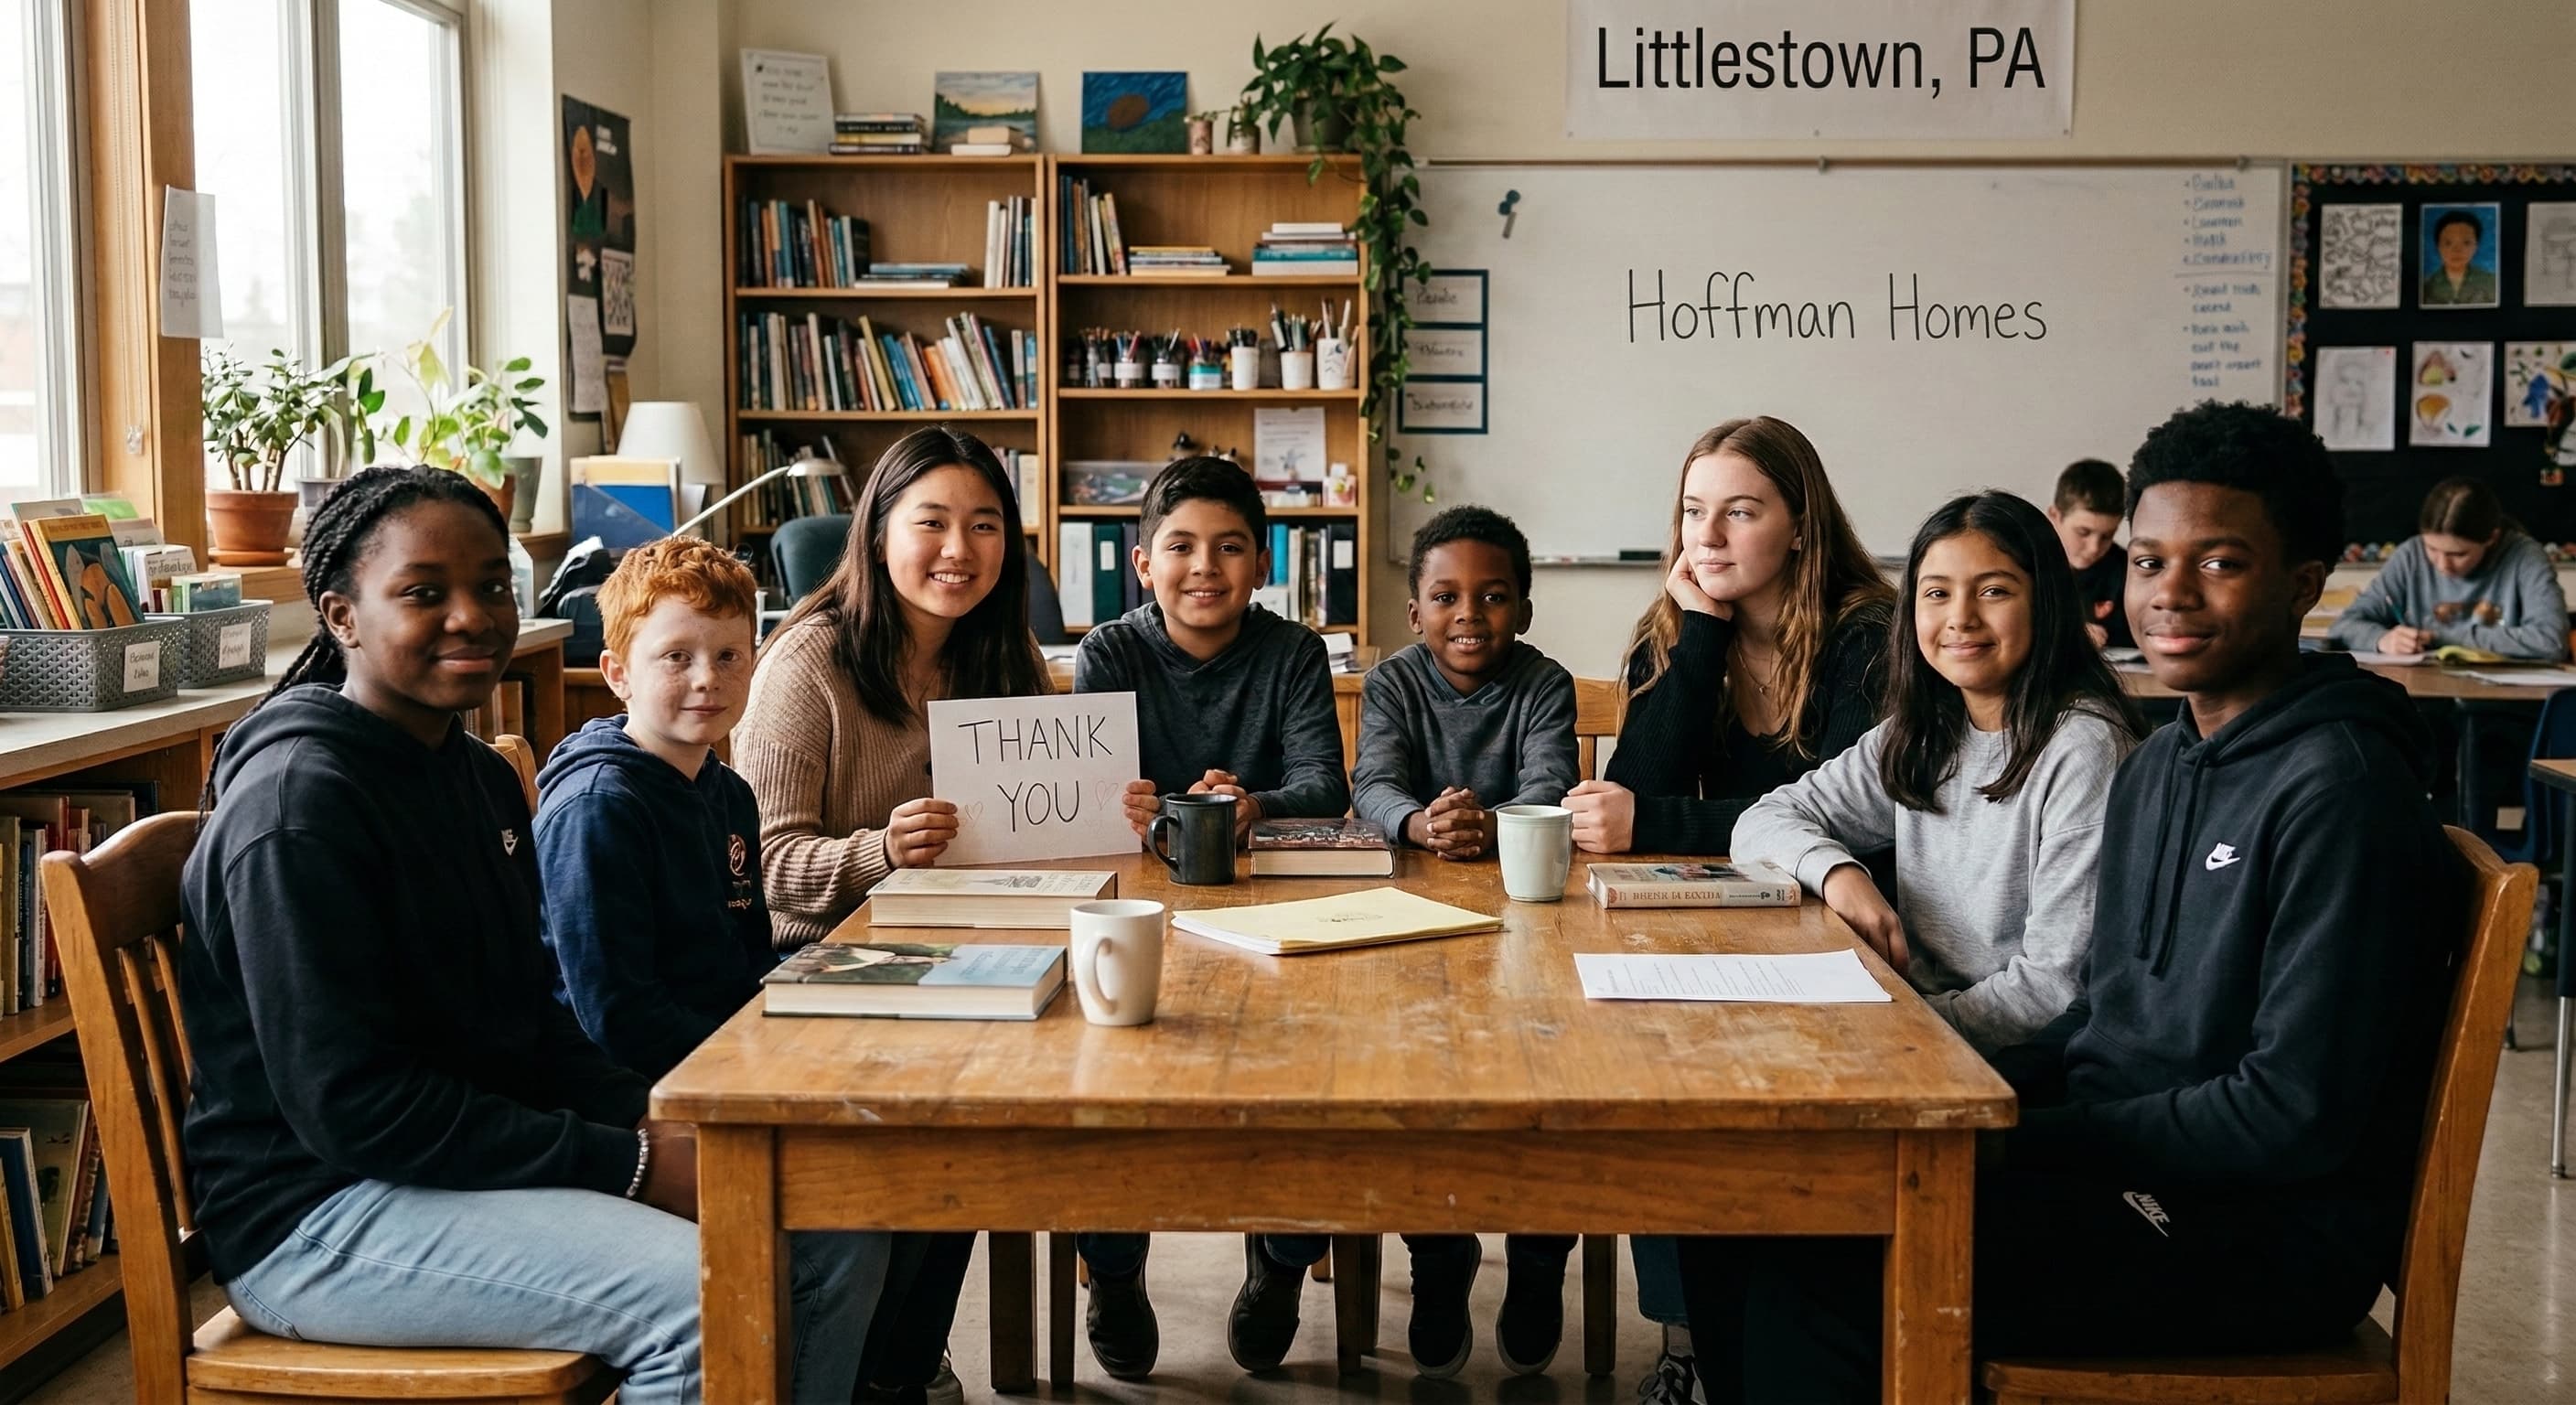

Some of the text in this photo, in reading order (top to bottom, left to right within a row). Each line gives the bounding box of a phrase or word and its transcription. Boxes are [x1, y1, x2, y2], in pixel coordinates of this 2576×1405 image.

[1598, 26, 2045, 100] Littlestown, PA
[1628, 269, 2047, 343] Hoffman Homes
[958, 714, 1112, 765] THANK
[997, 780, 1080, 833] YOU
